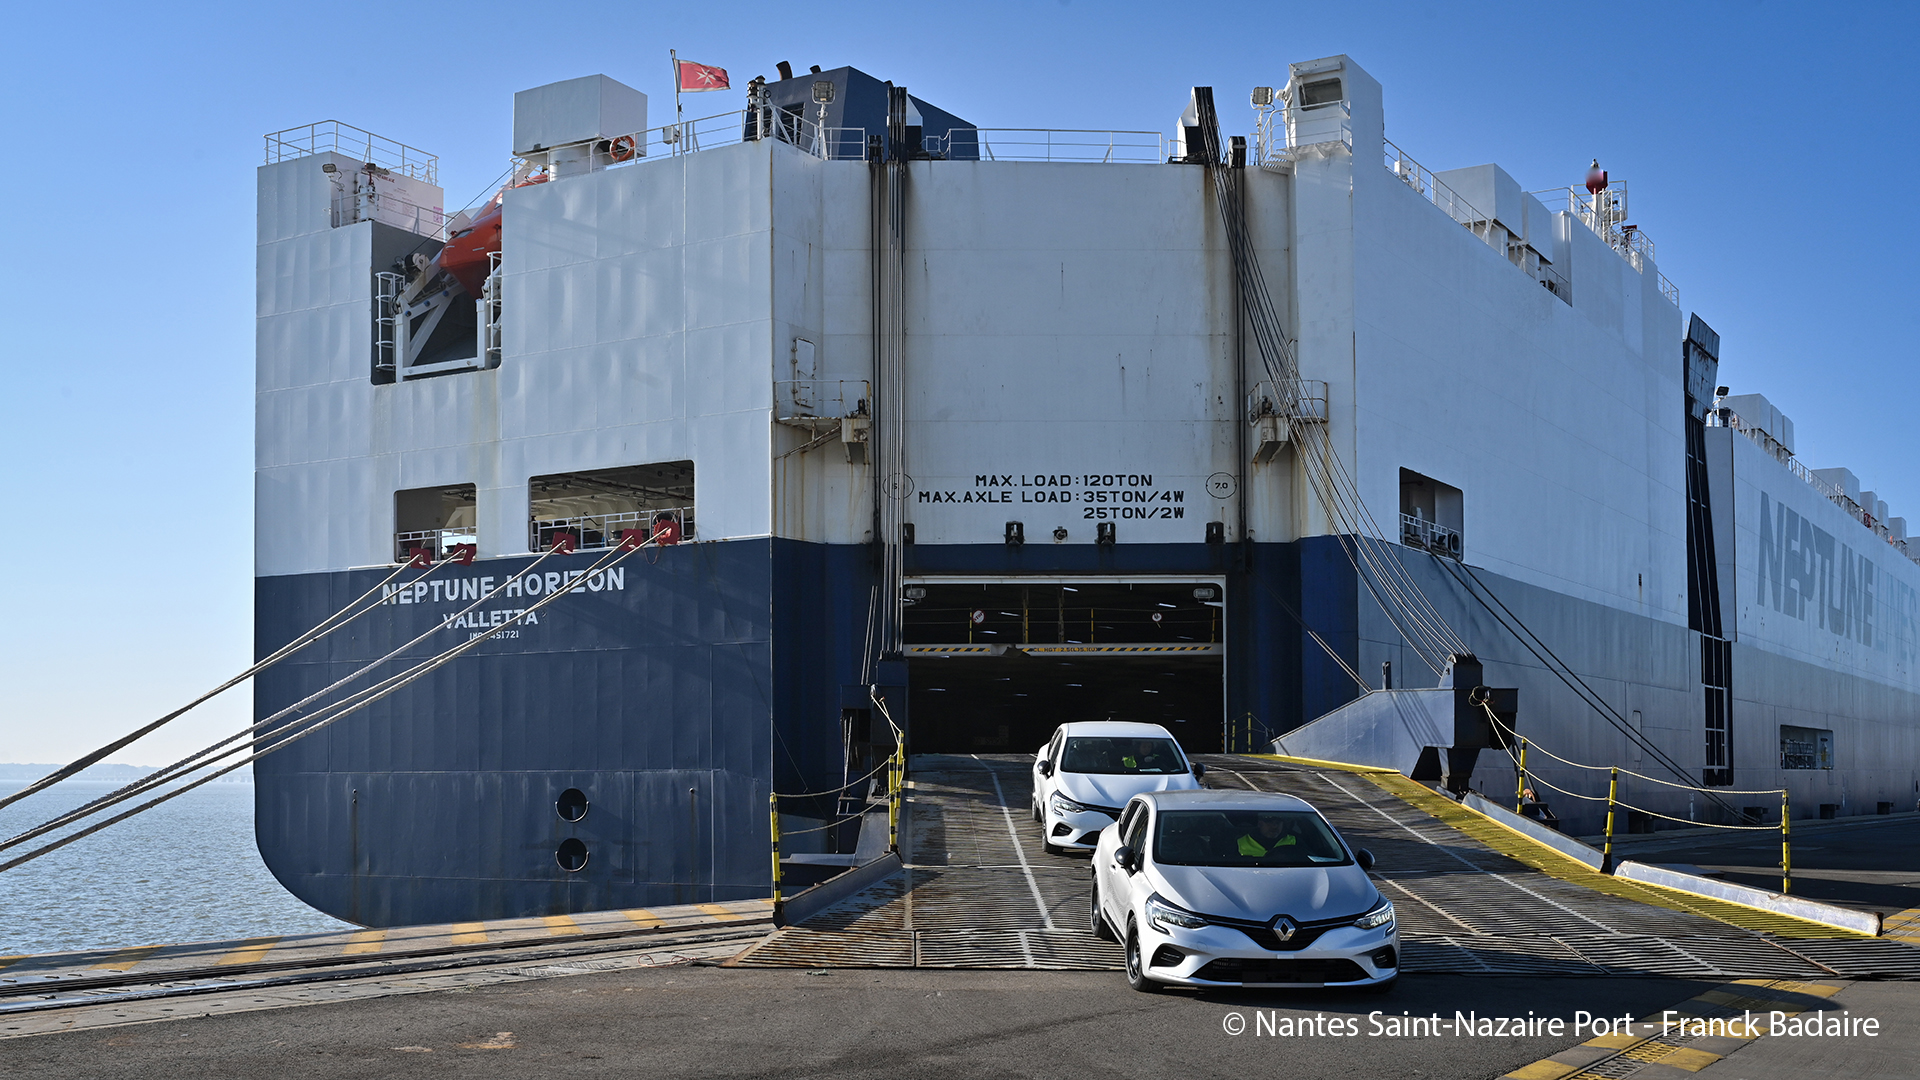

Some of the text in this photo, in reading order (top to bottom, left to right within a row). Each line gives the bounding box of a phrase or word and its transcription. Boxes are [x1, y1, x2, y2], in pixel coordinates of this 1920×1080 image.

[1214, 481, 1229, 490] 7.0
[1083, 506, 1185, 520] 25TON/2W
[382, 567, 625, 605] NEPTUNE HORIZON
[1757, 490, 1917, 665] NEPTUNE LINES
[443, 609, 539, 629] VALLETTA
